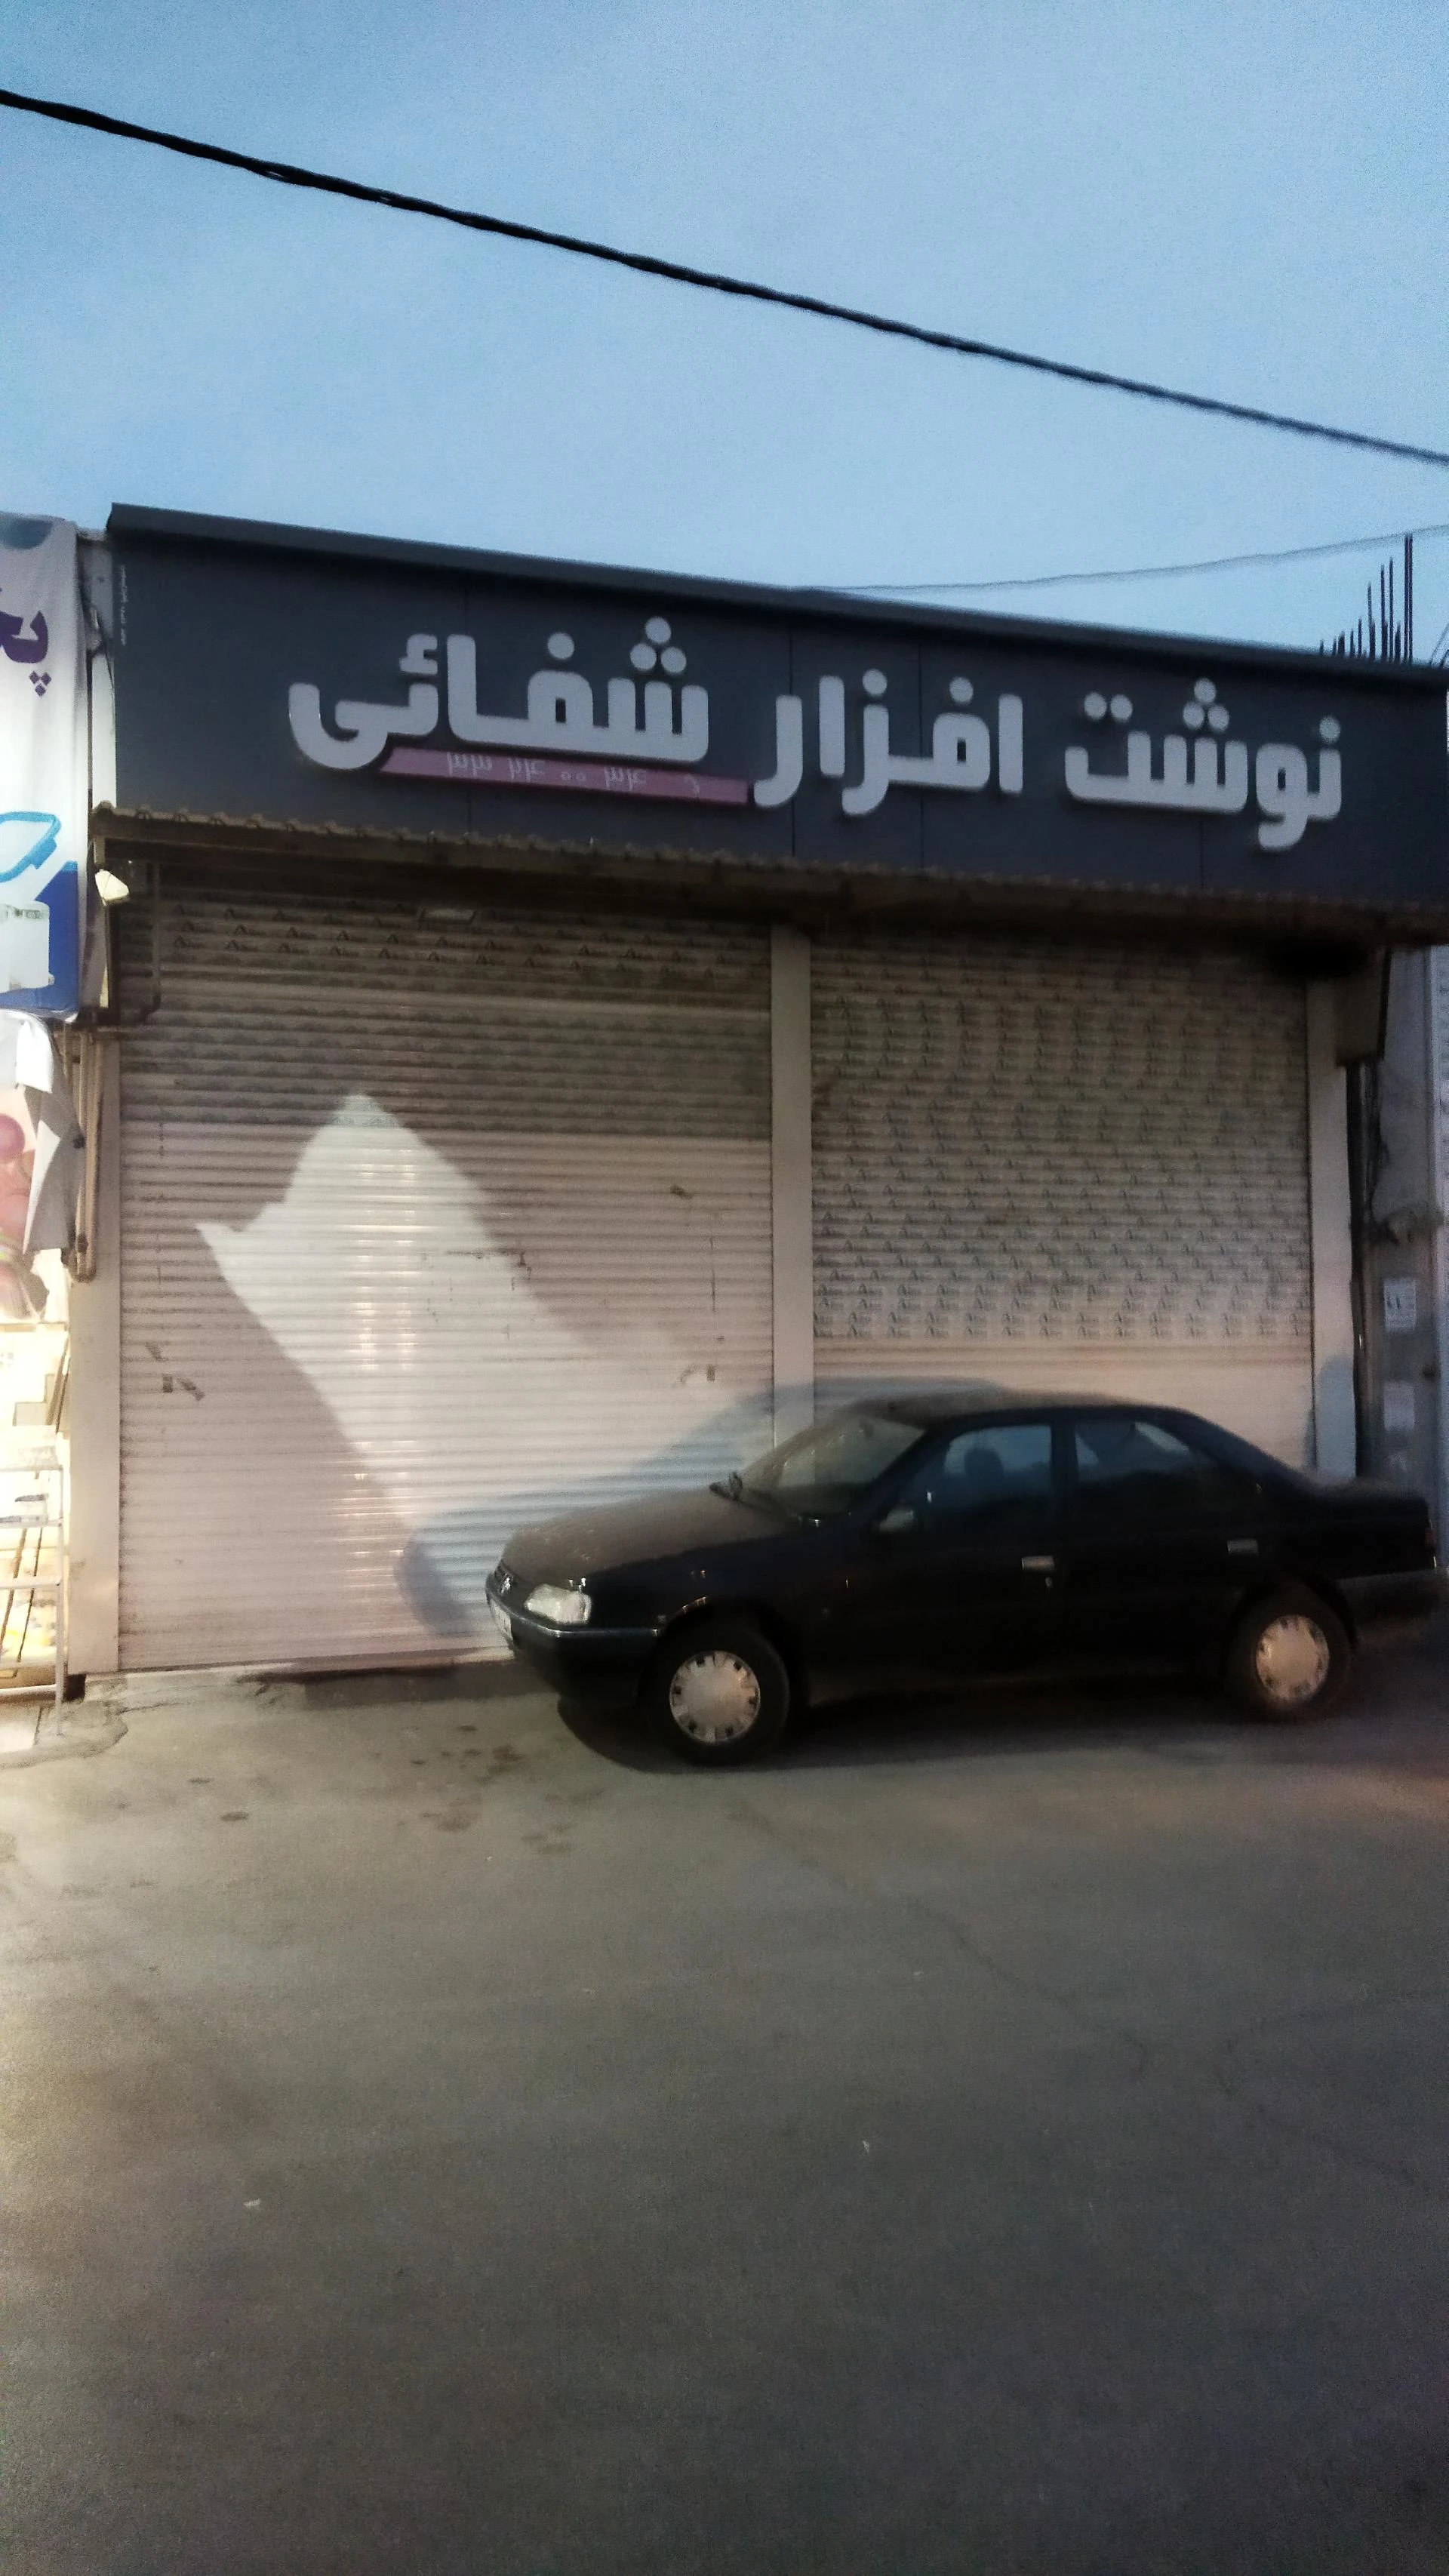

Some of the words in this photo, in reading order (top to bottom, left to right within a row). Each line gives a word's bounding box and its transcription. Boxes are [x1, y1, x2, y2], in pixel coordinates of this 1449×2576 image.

[288, 617, 709, 771] شفائی
[753, 669, 1024, 815] افزار
[1065, 679, 1342, 850] نوشت
